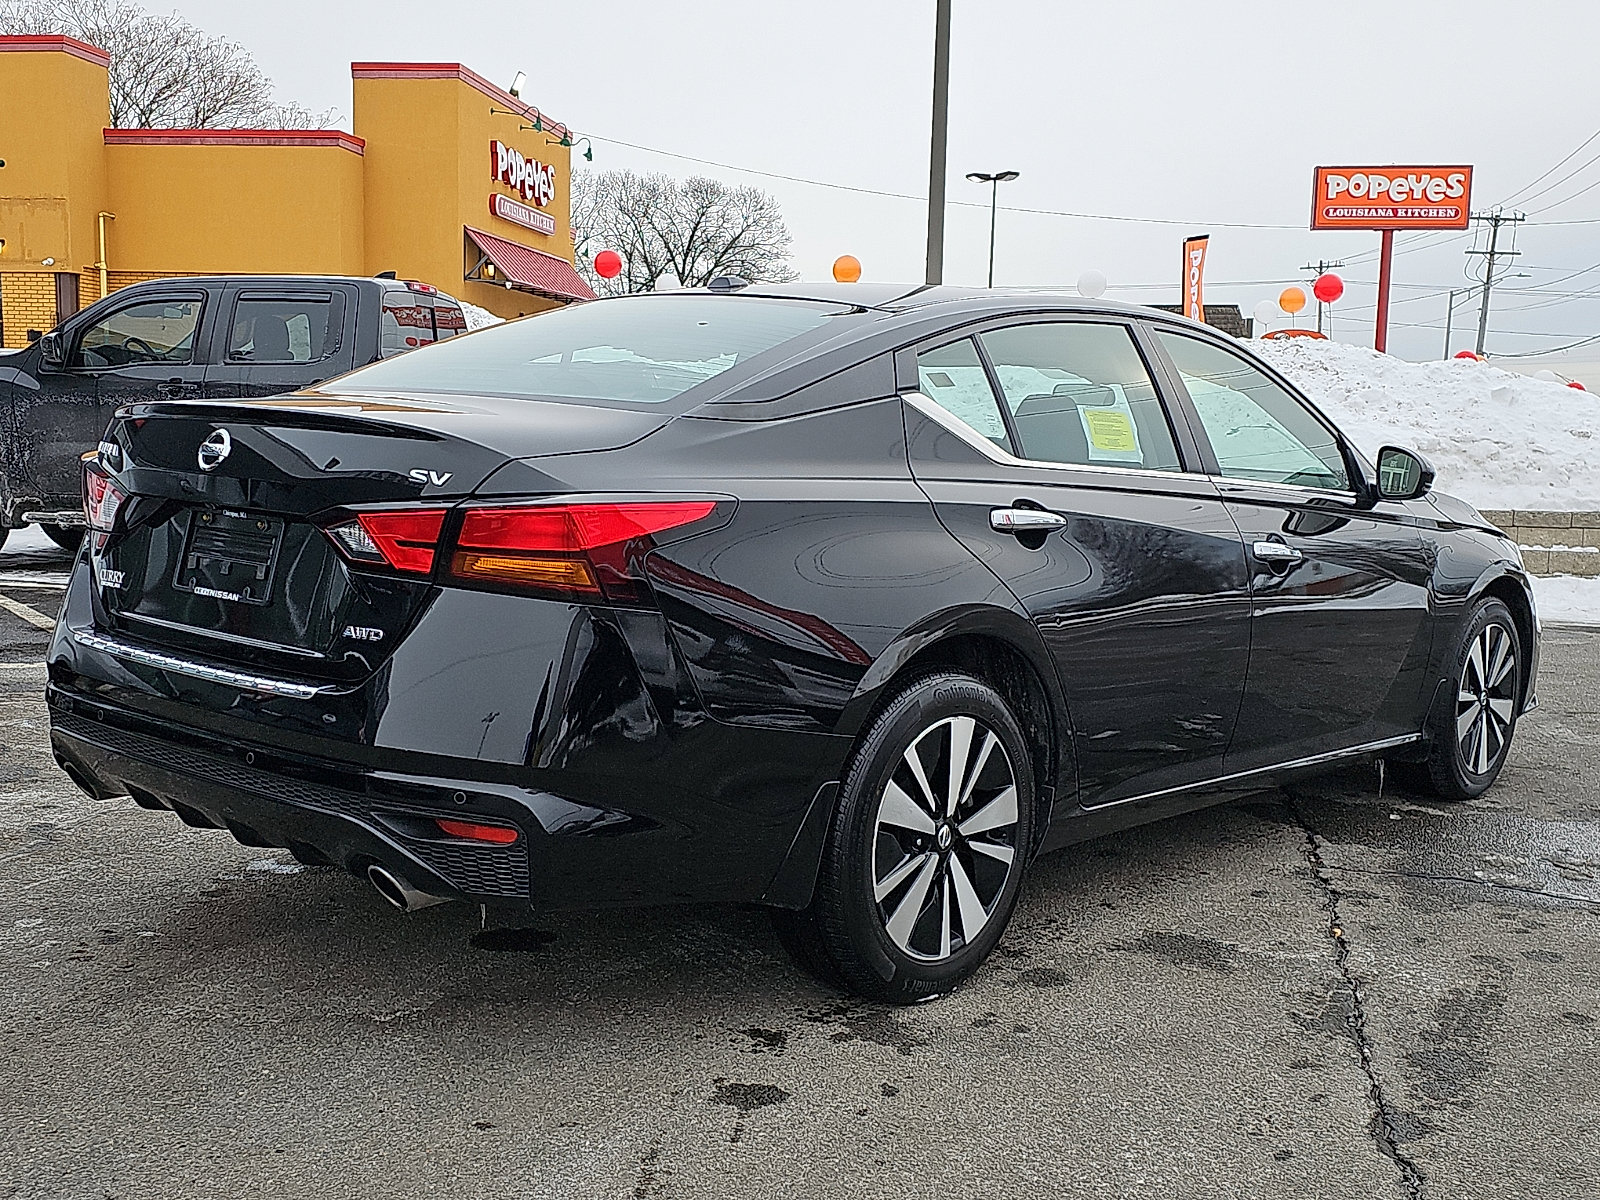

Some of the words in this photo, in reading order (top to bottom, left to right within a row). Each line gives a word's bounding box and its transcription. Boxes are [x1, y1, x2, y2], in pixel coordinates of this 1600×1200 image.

[1328, 208, 1395, 217] LOUISIANA
[1396, 207, 1458, 217] KITCHEN
[1189, 248, 1203, 321] POPe
[408, 469, 453, 486] SV
[343, 625, 384, 641] AWD
